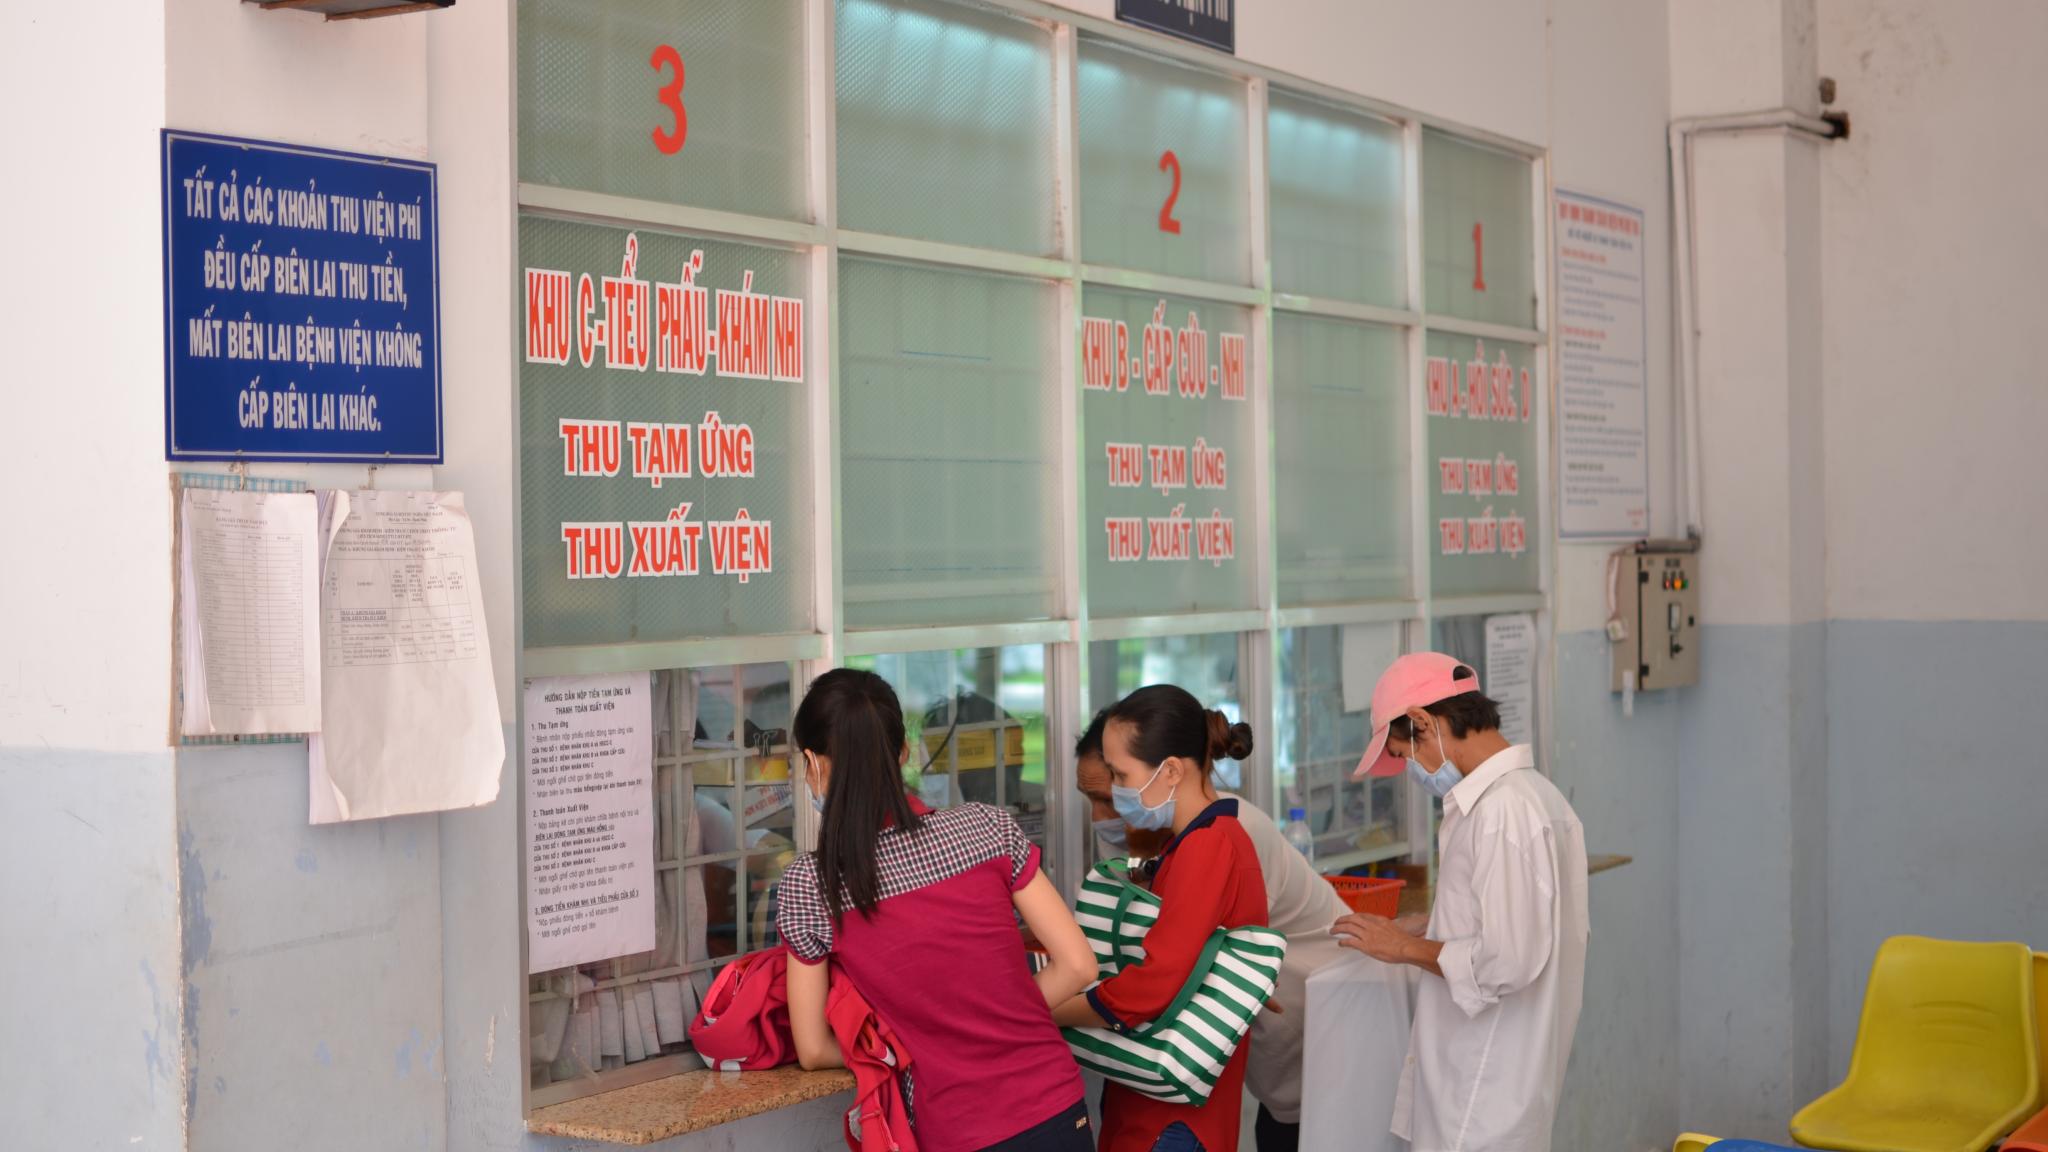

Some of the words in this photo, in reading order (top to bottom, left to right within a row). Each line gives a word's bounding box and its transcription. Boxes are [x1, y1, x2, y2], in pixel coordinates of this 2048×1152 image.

[649, 45, 687, 155] 3
[184, 165, 213, 219] TẤT
[220, 170, 239, 221] CẢ
[244, 177, 273, 223] CÁC
[279, 180, 326, 230] KHOẢN
[330, 196, 358, 233] THU
[363, 192, 394, 244] VIỆN
[399, 197, 420, 240] PHÍ
[1158, 150, 1182, 234] 2
[204, 235, 235, 291] ĐỀU
[241, 240, 270, 292] CẤP
[275, 249, 309, 295] BIÊN
[314, 260, 336, 297] LAI
[340, 262, 367, 300] THU
[371, 252, 407, 310] TIỀN,
[1472, 221, 1485, 292] 1
[189, 305, 221, 358] MẤT
[228, 312, 262, 359] BIÊN
[269, 323, 291, 361] LAI
[296, 317, 334, 370] BỆNH
[339, 319, 371, 372] VIỆN
[376, 323, 421, 368] KHÔNG
[526, 269, 571, 363] KHU
[772, 296, 804, 383] NHI
[1082, 316, 1112, 390] KHU
[1116, 320, 1129, 393] B
[1143, 300, 1173, 396] CẤP
[1177, 312, 1207, 398] CỨU
[1221, 334, 1246, 401] NHI
[239, 376, 268, 428] CẤP
[274, 382, 307, 429] BIÊN
[313, 394, 334, 430] LAI
[340, 385, 381, 431] KHÁC.
[560, 419, 621, 477] THU
[627, 422, 691, 487] TẠM
[699, 412, 754, 479] ỨNG
[1107, 443, 1142, 486] THU
[1149, 446, 1186, 495] TẠM
[1193, 438, 1226, 488] ỨNG
[1440, 458, 1464, 495] THU
[1467, 458, 1492, 501] TẠM
[1496, 453, 1518, 496] ỨNG
[562, 522, 624, 579] THU
[628, 503, 702, 577] XUẤT
[708, 509, 771, 582] VIỆN
[1106, 518, 1142, 560] THU
[1148, 504, 1191, 560] XUẤT
[1196, 509, 1234, 565] VIỆN
[1441, 519, 1464, 554] THU
[1468, 506, 1496, 555] XUẤT
[1500, 513, 1526, 559] VIỆN
[555, 706, 572, 715] THANH
[574, 703, 587, 713] TOÁN
[589, 702, 601, 712] XUẤT
[603, 701, 614, 711] VIỆN
